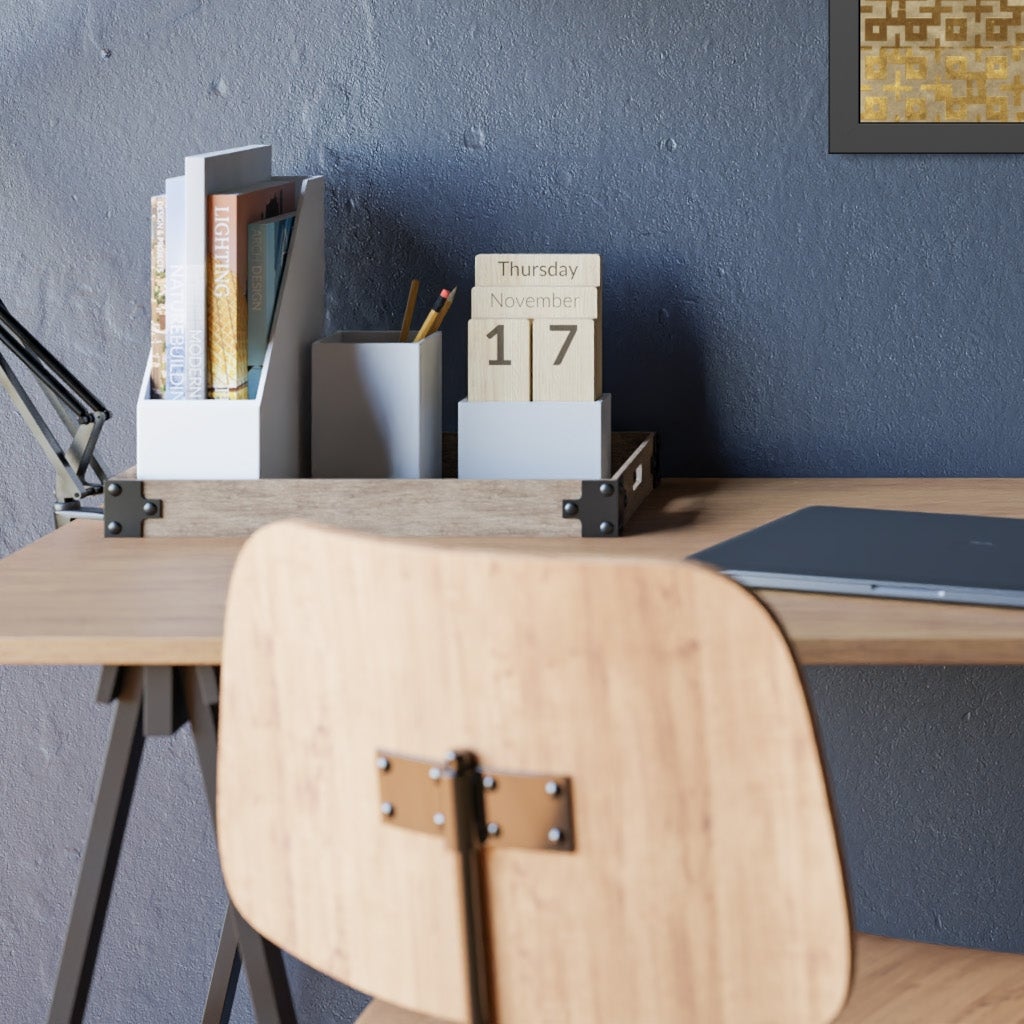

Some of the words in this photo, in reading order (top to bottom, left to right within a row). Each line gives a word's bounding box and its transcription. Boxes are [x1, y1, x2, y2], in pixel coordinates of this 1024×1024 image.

[213, 205, 230, 299] LIGHTING
[498, 261, 578, 280] Thursday
[251, 265, 264, 311] DESIGN
[490, 293, 580, 308] November
[188, 329, 202, 398] MODERN
